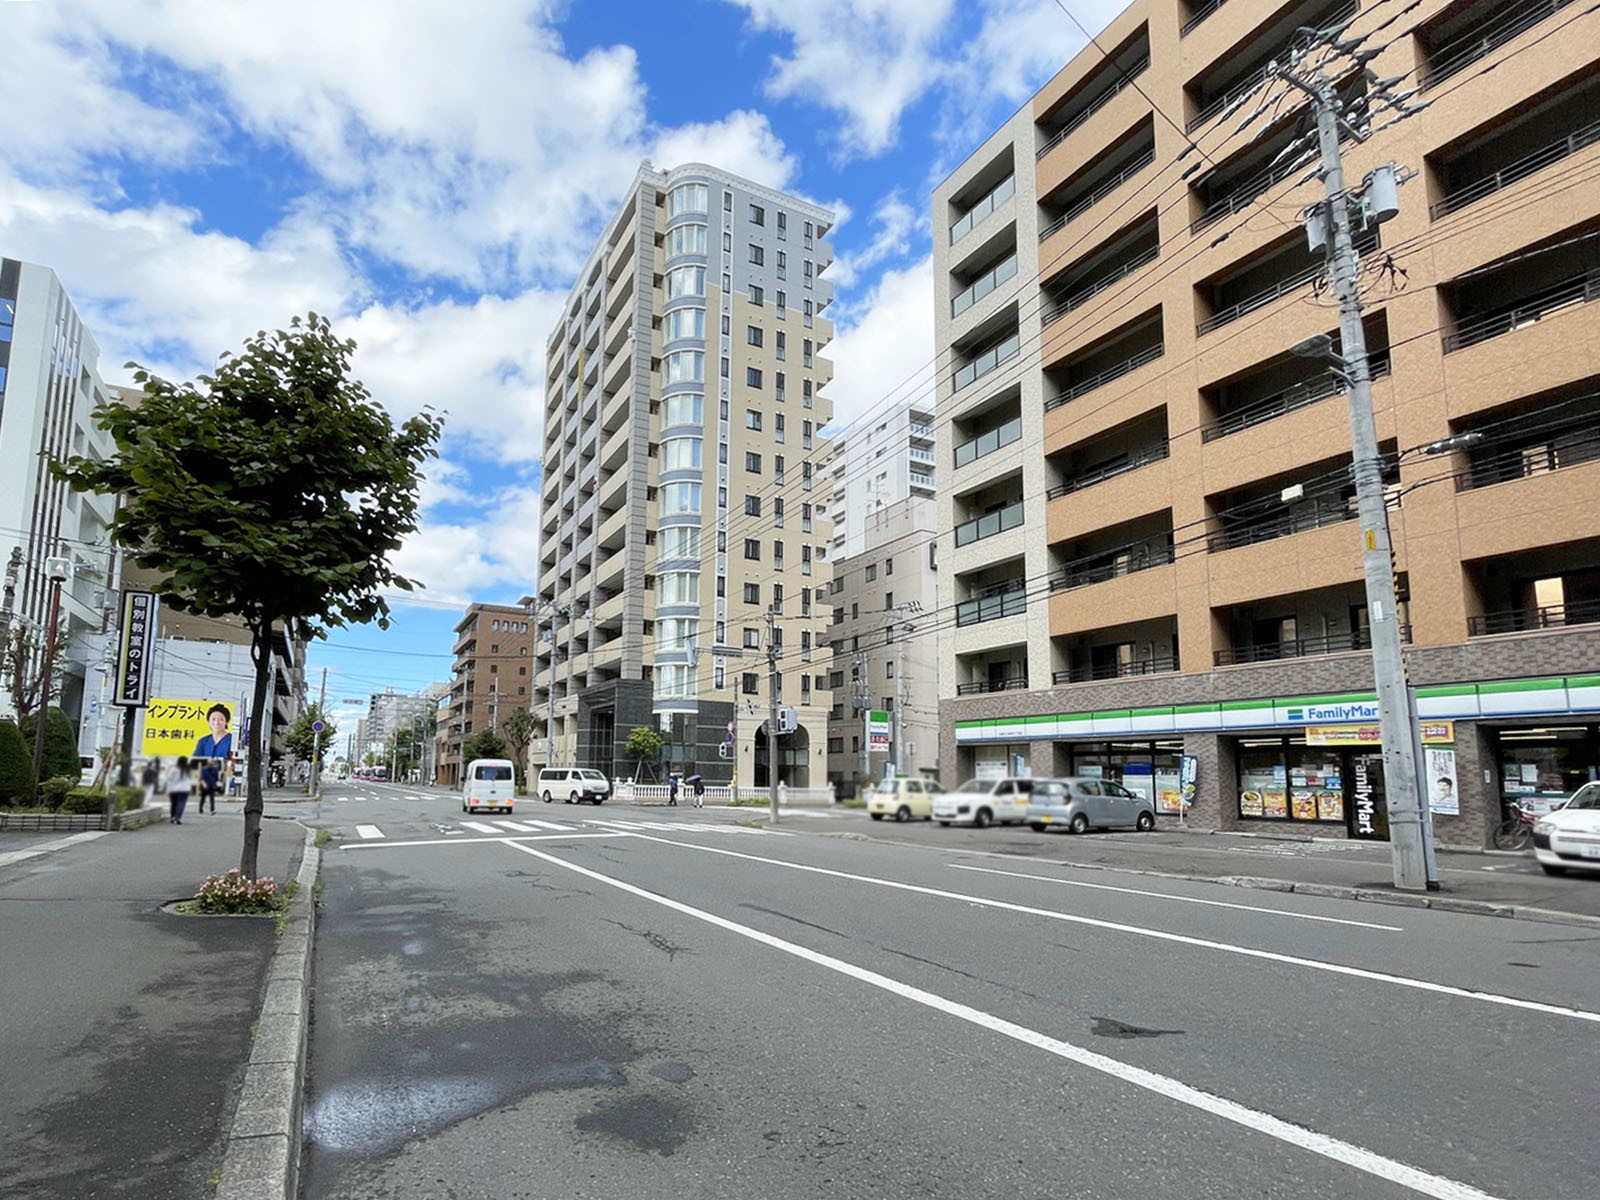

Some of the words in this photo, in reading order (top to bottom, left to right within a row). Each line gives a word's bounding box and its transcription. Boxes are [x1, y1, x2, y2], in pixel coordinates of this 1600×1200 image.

[126, 596, 146, 698] 個別教室のトライ
[145, 728, 195, 740] 日本歯科
[1308, 705, 1378, 720] FamilyMar
[1354, 755, 1374, 834] FamilyMart
